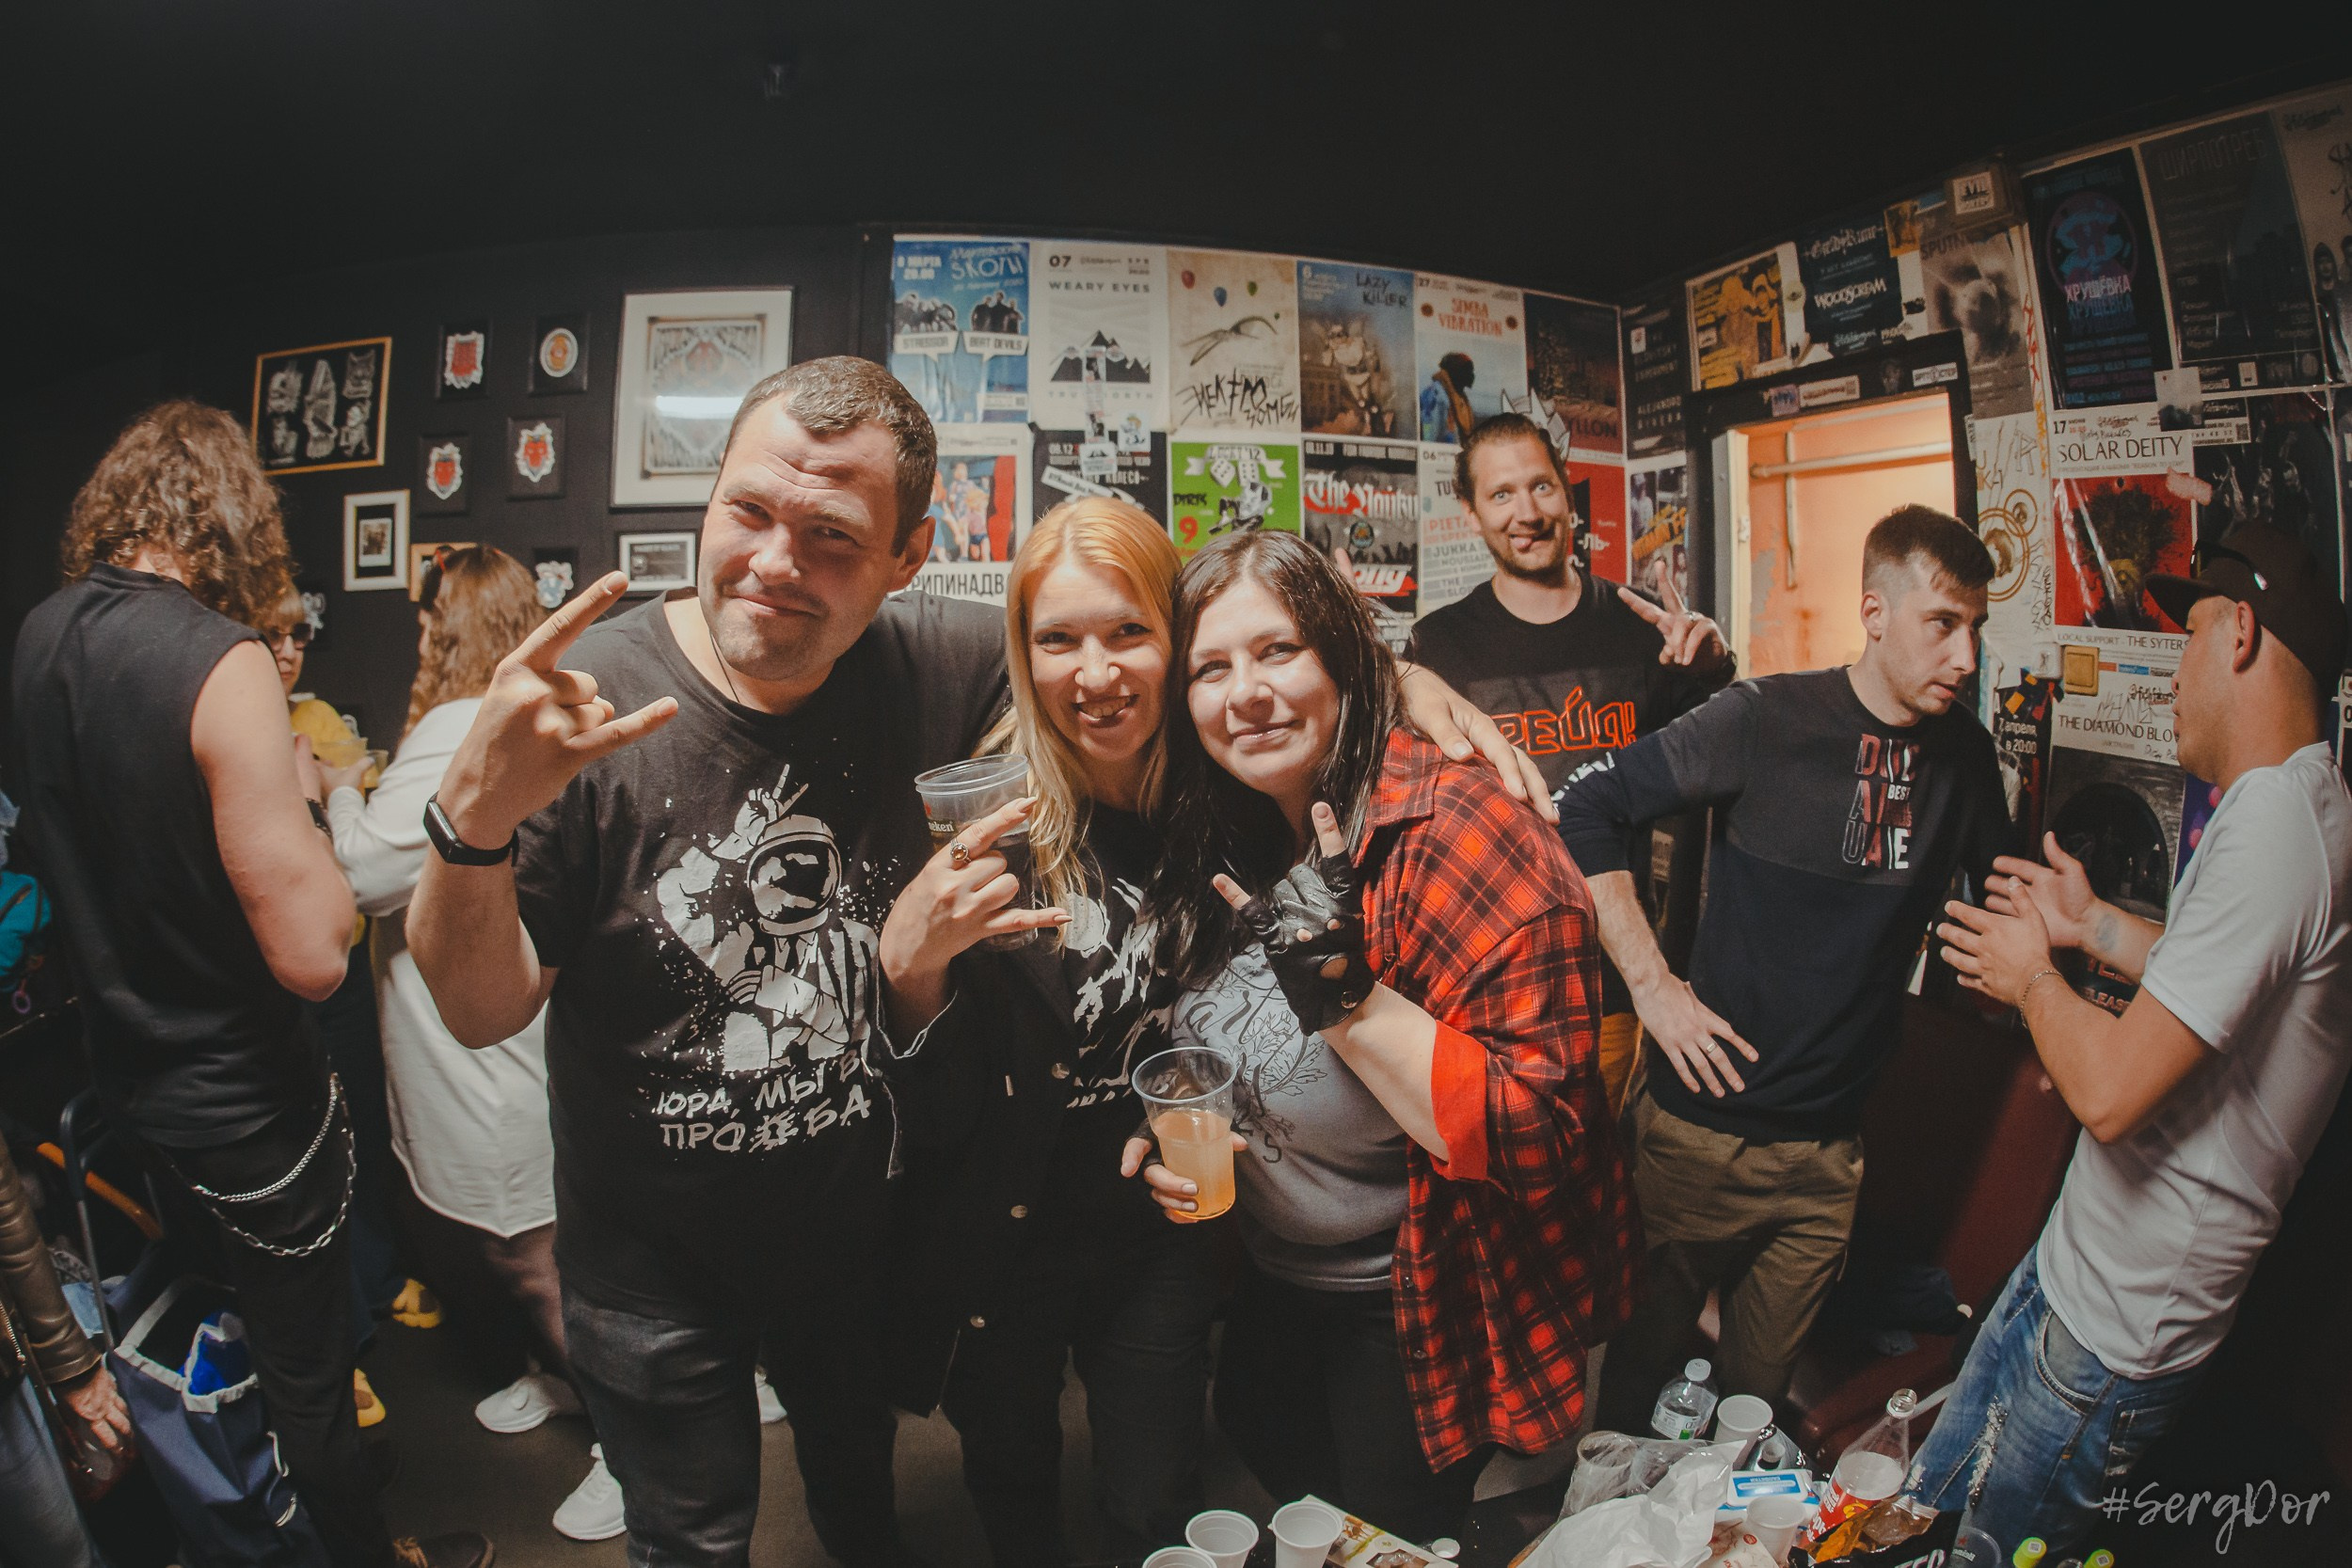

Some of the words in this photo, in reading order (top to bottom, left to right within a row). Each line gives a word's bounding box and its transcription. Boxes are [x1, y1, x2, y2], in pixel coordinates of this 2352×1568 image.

[1049, 255, 1072, 268] 07
[1049, 281, 1104, 292] WEARY
[1112, 283, 1150, 293] EYES
[1452, 297, 1489, 319] SIMBA
[1438, 312, 1503, 337] VIBRATION
[2053, 420, 2066, 435] 17
[2058, 438, 2121, 463] SOLAR
[2125, 436, 2183, 459] DEITY
[1179, 515, 1199, 545] 9
[1429, 518, 1470, 531] PIETA
[1433, 543, 1477, 557] JUKKA
[911, 573, 1011, 597] РИПИНАДВ
[2058, 633, 2083, 642] LOCAL
[2086, 635, 2120, 645] SUPPORT
[2127, 635, 2147, 647] THE
[2058, 715, 2080, 730] THE
[2083, 718, 2144, 738] DIAMOND
[2147, 726, 2176, 743] BLO
[1887, 784, 1911, 800] BEST
[657, 1086, 740, 1119] ЮРА,
[755, 1060, 826, 1111] МЫ
